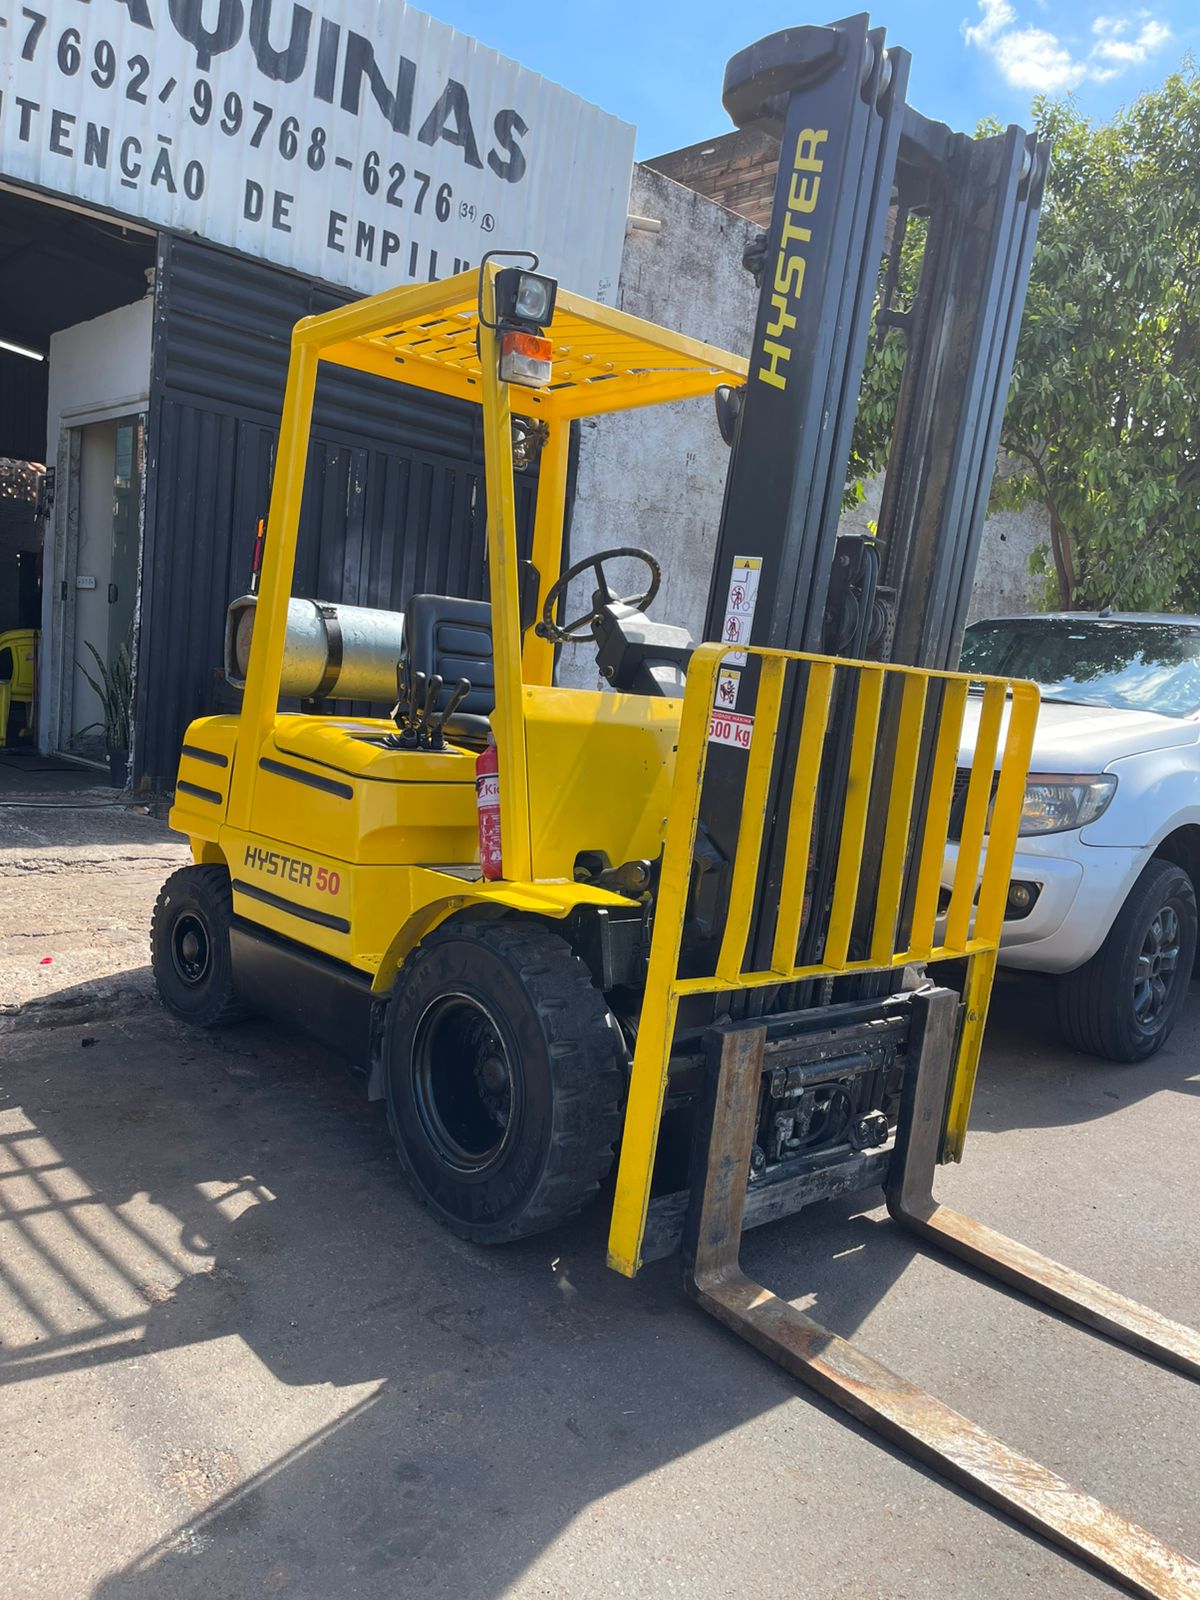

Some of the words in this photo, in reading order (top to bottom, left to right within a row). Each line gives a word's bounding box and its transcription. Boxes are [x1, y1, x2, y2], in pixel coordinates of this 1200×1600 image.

[0, 90, 205, 201] TENÇÃO
[244, 178, 294, 233] DE
[77, 0, 528, 183] QUINAS
[758, 128, 829, 391] HYSTER
[735, 725, 750, 747] kg
[244, 845, 313, 888] HYSTER
[315, 867, 340, 896] 50
